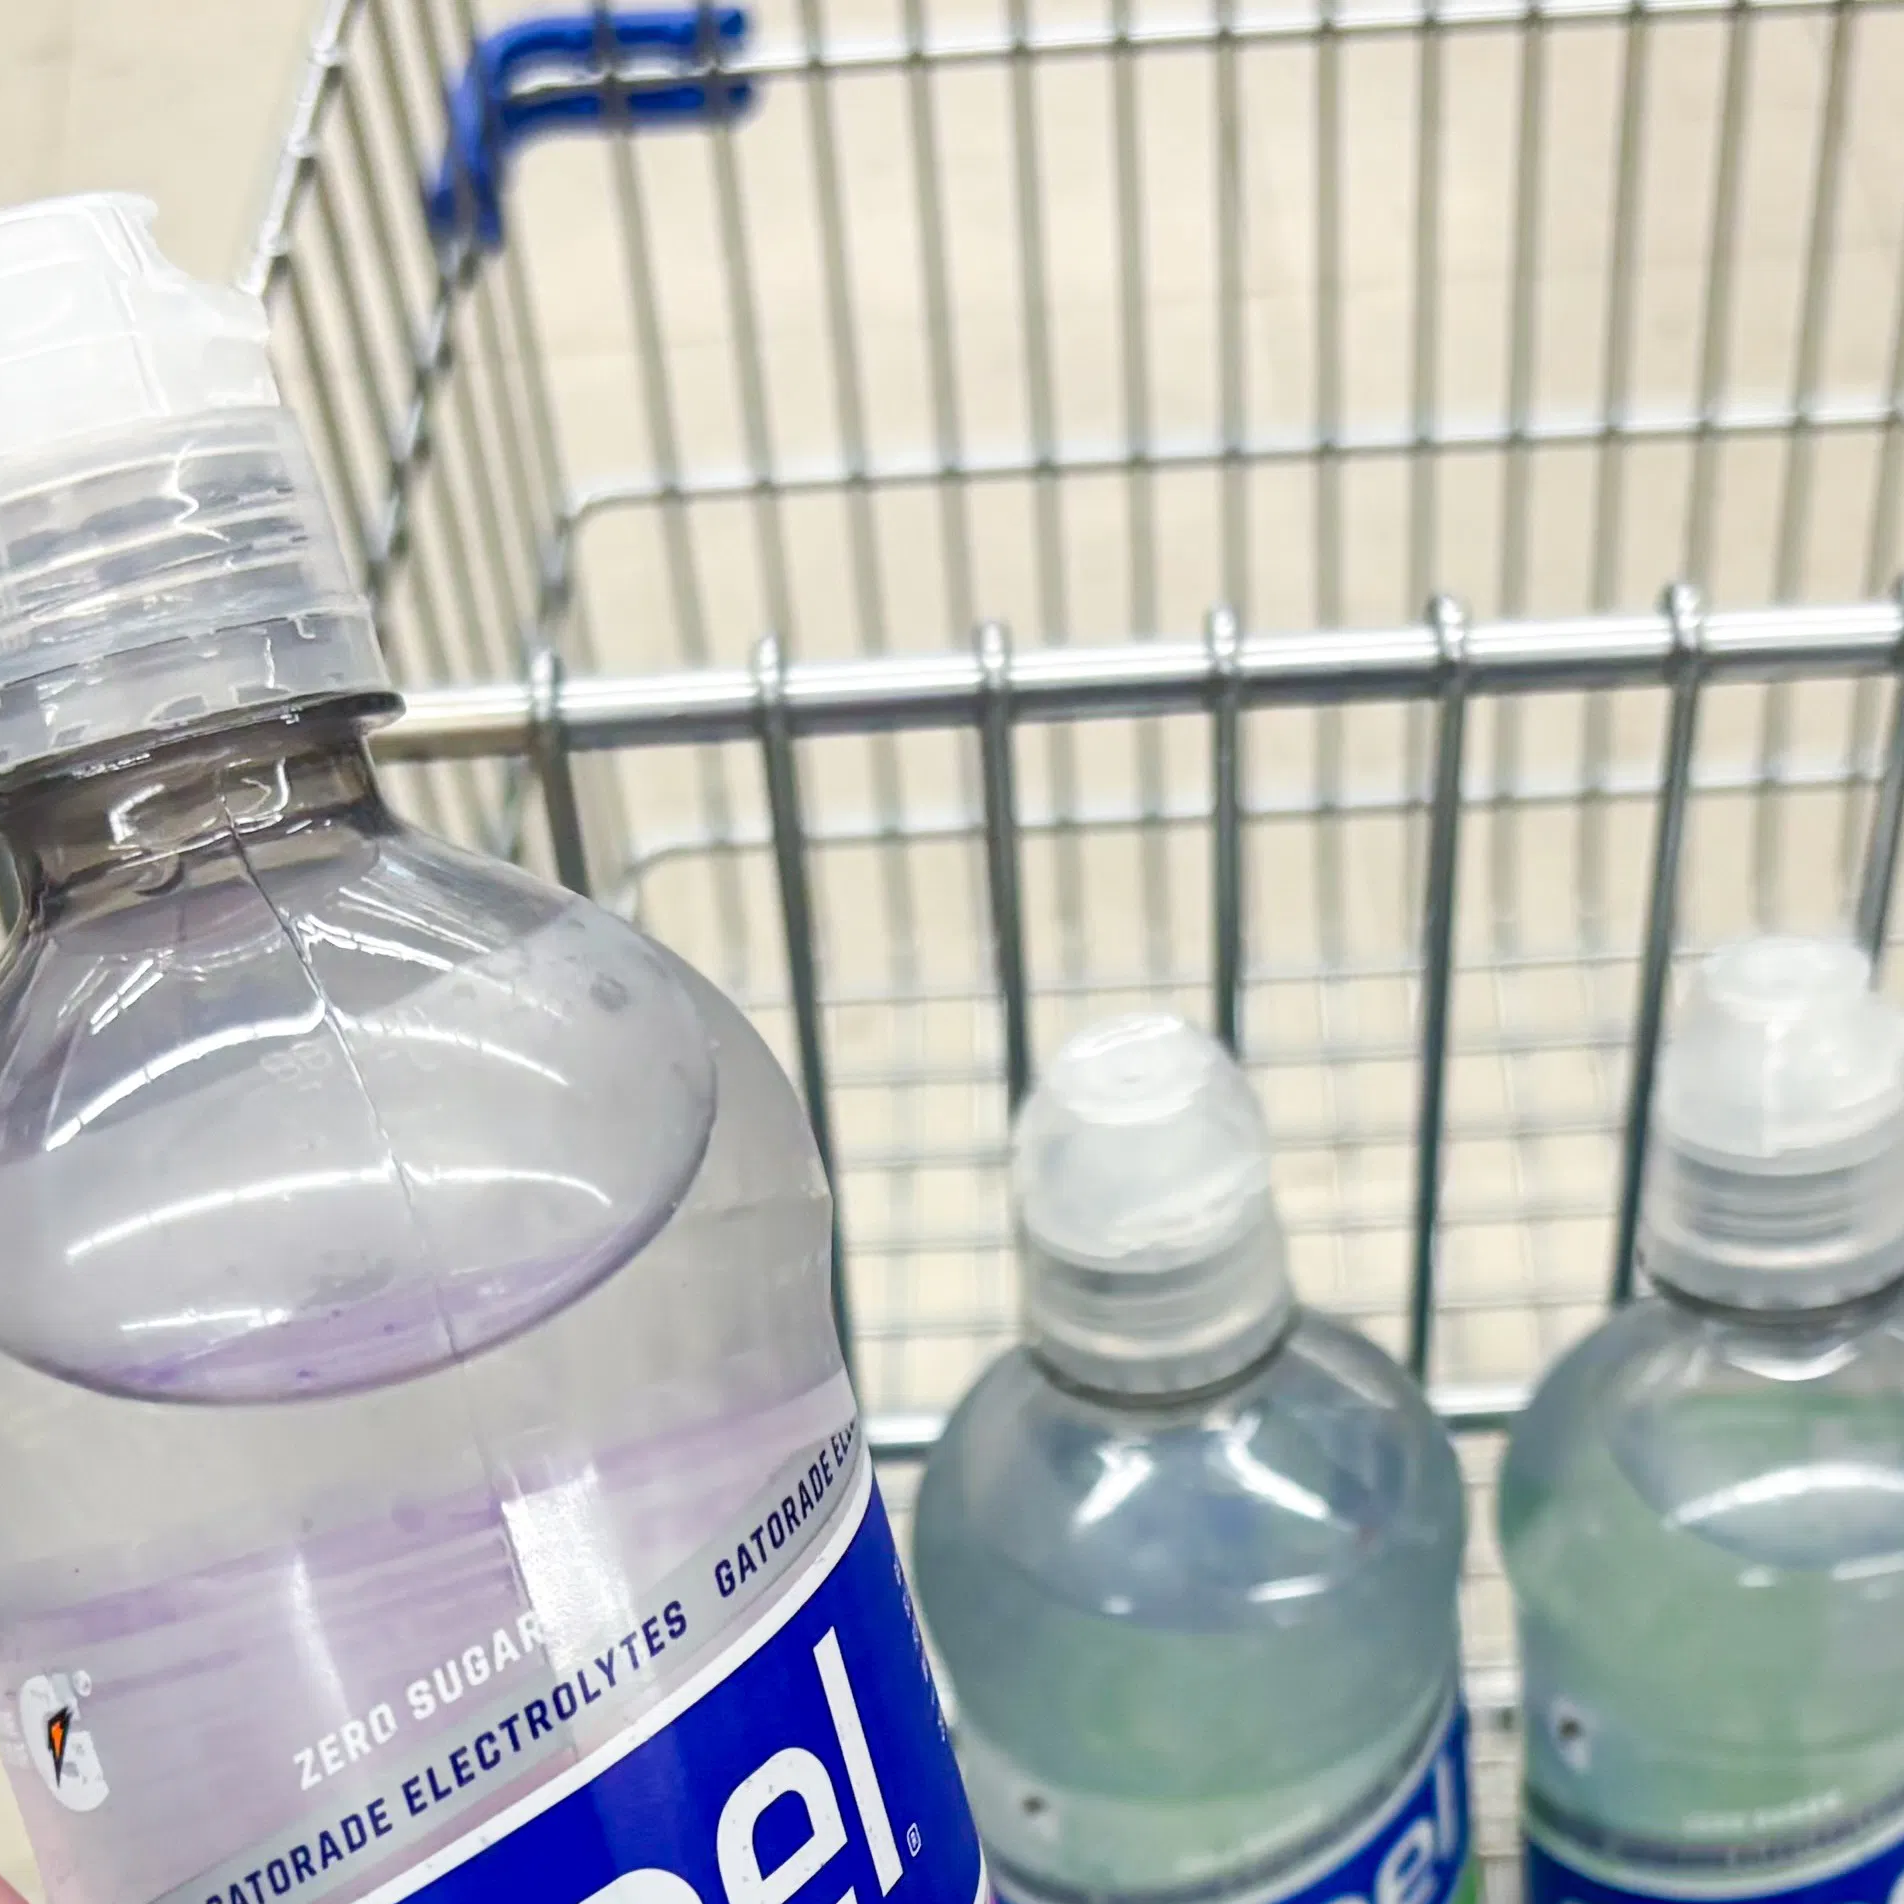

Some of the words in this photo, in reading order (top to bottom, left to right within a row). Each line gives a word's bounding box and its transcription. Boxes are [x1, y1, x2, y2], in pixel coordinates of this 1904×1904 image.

[293, 1702, 396, 1790] ZERO
[410, 1610, 543, 1721] SUGAR
[402, 1599, 687, 1816] ELECTROLYTES
[715, 1452, 834, 1598] GATORADE
